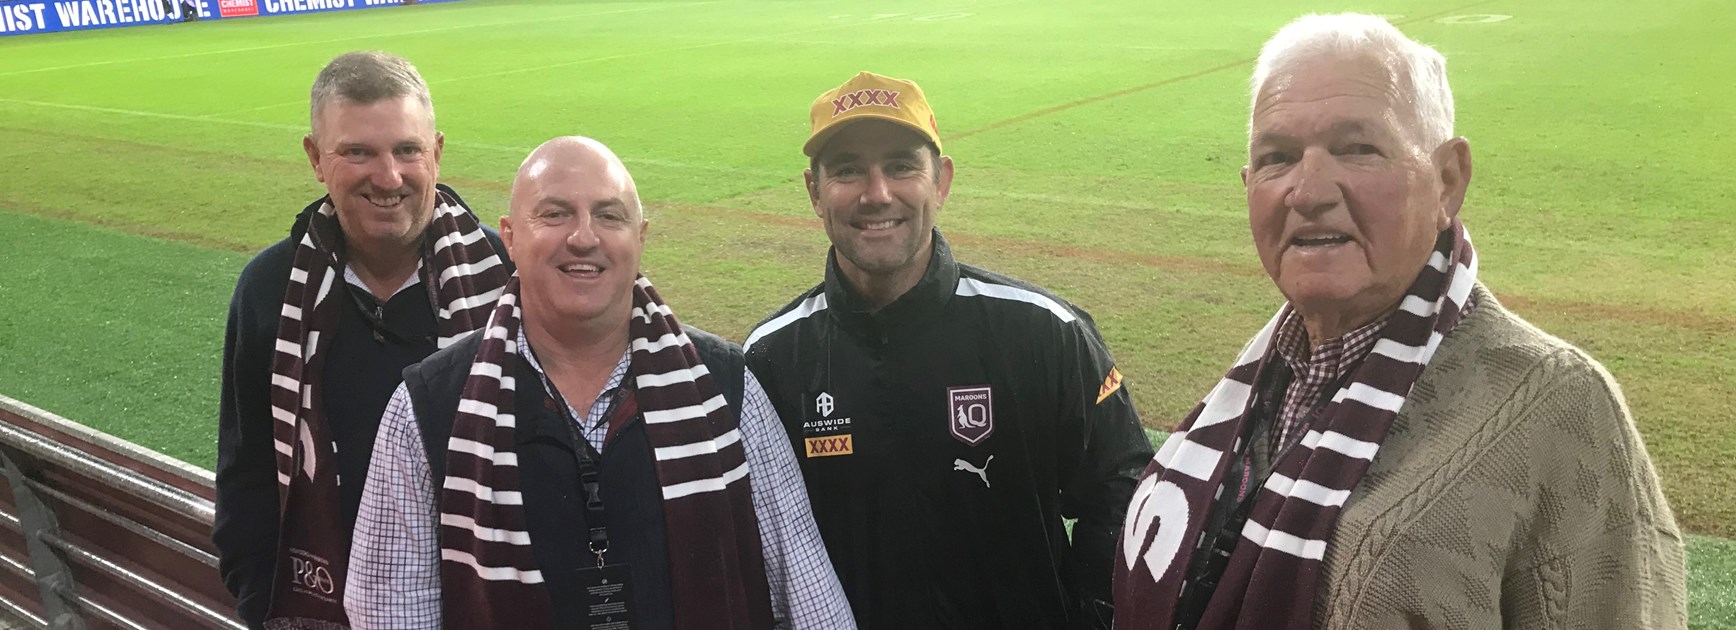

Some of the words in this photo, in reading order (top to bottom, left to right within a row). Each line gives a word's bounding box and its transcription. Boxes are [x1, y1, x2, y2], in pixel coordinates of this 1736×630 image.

[54, 0, 211, 28] WAREHOUE
[831, 88, 900, 118] XXXX
[1099, 369, 1119, 397] XX
[954, 393, 987, 402] MAROONS
[803, 417, 851, 429] AUSWIDE
[967, 403, 987, 427] Q
[808, 437, 850, 454] XXXX
[290, 556, 334, 594] P&O
